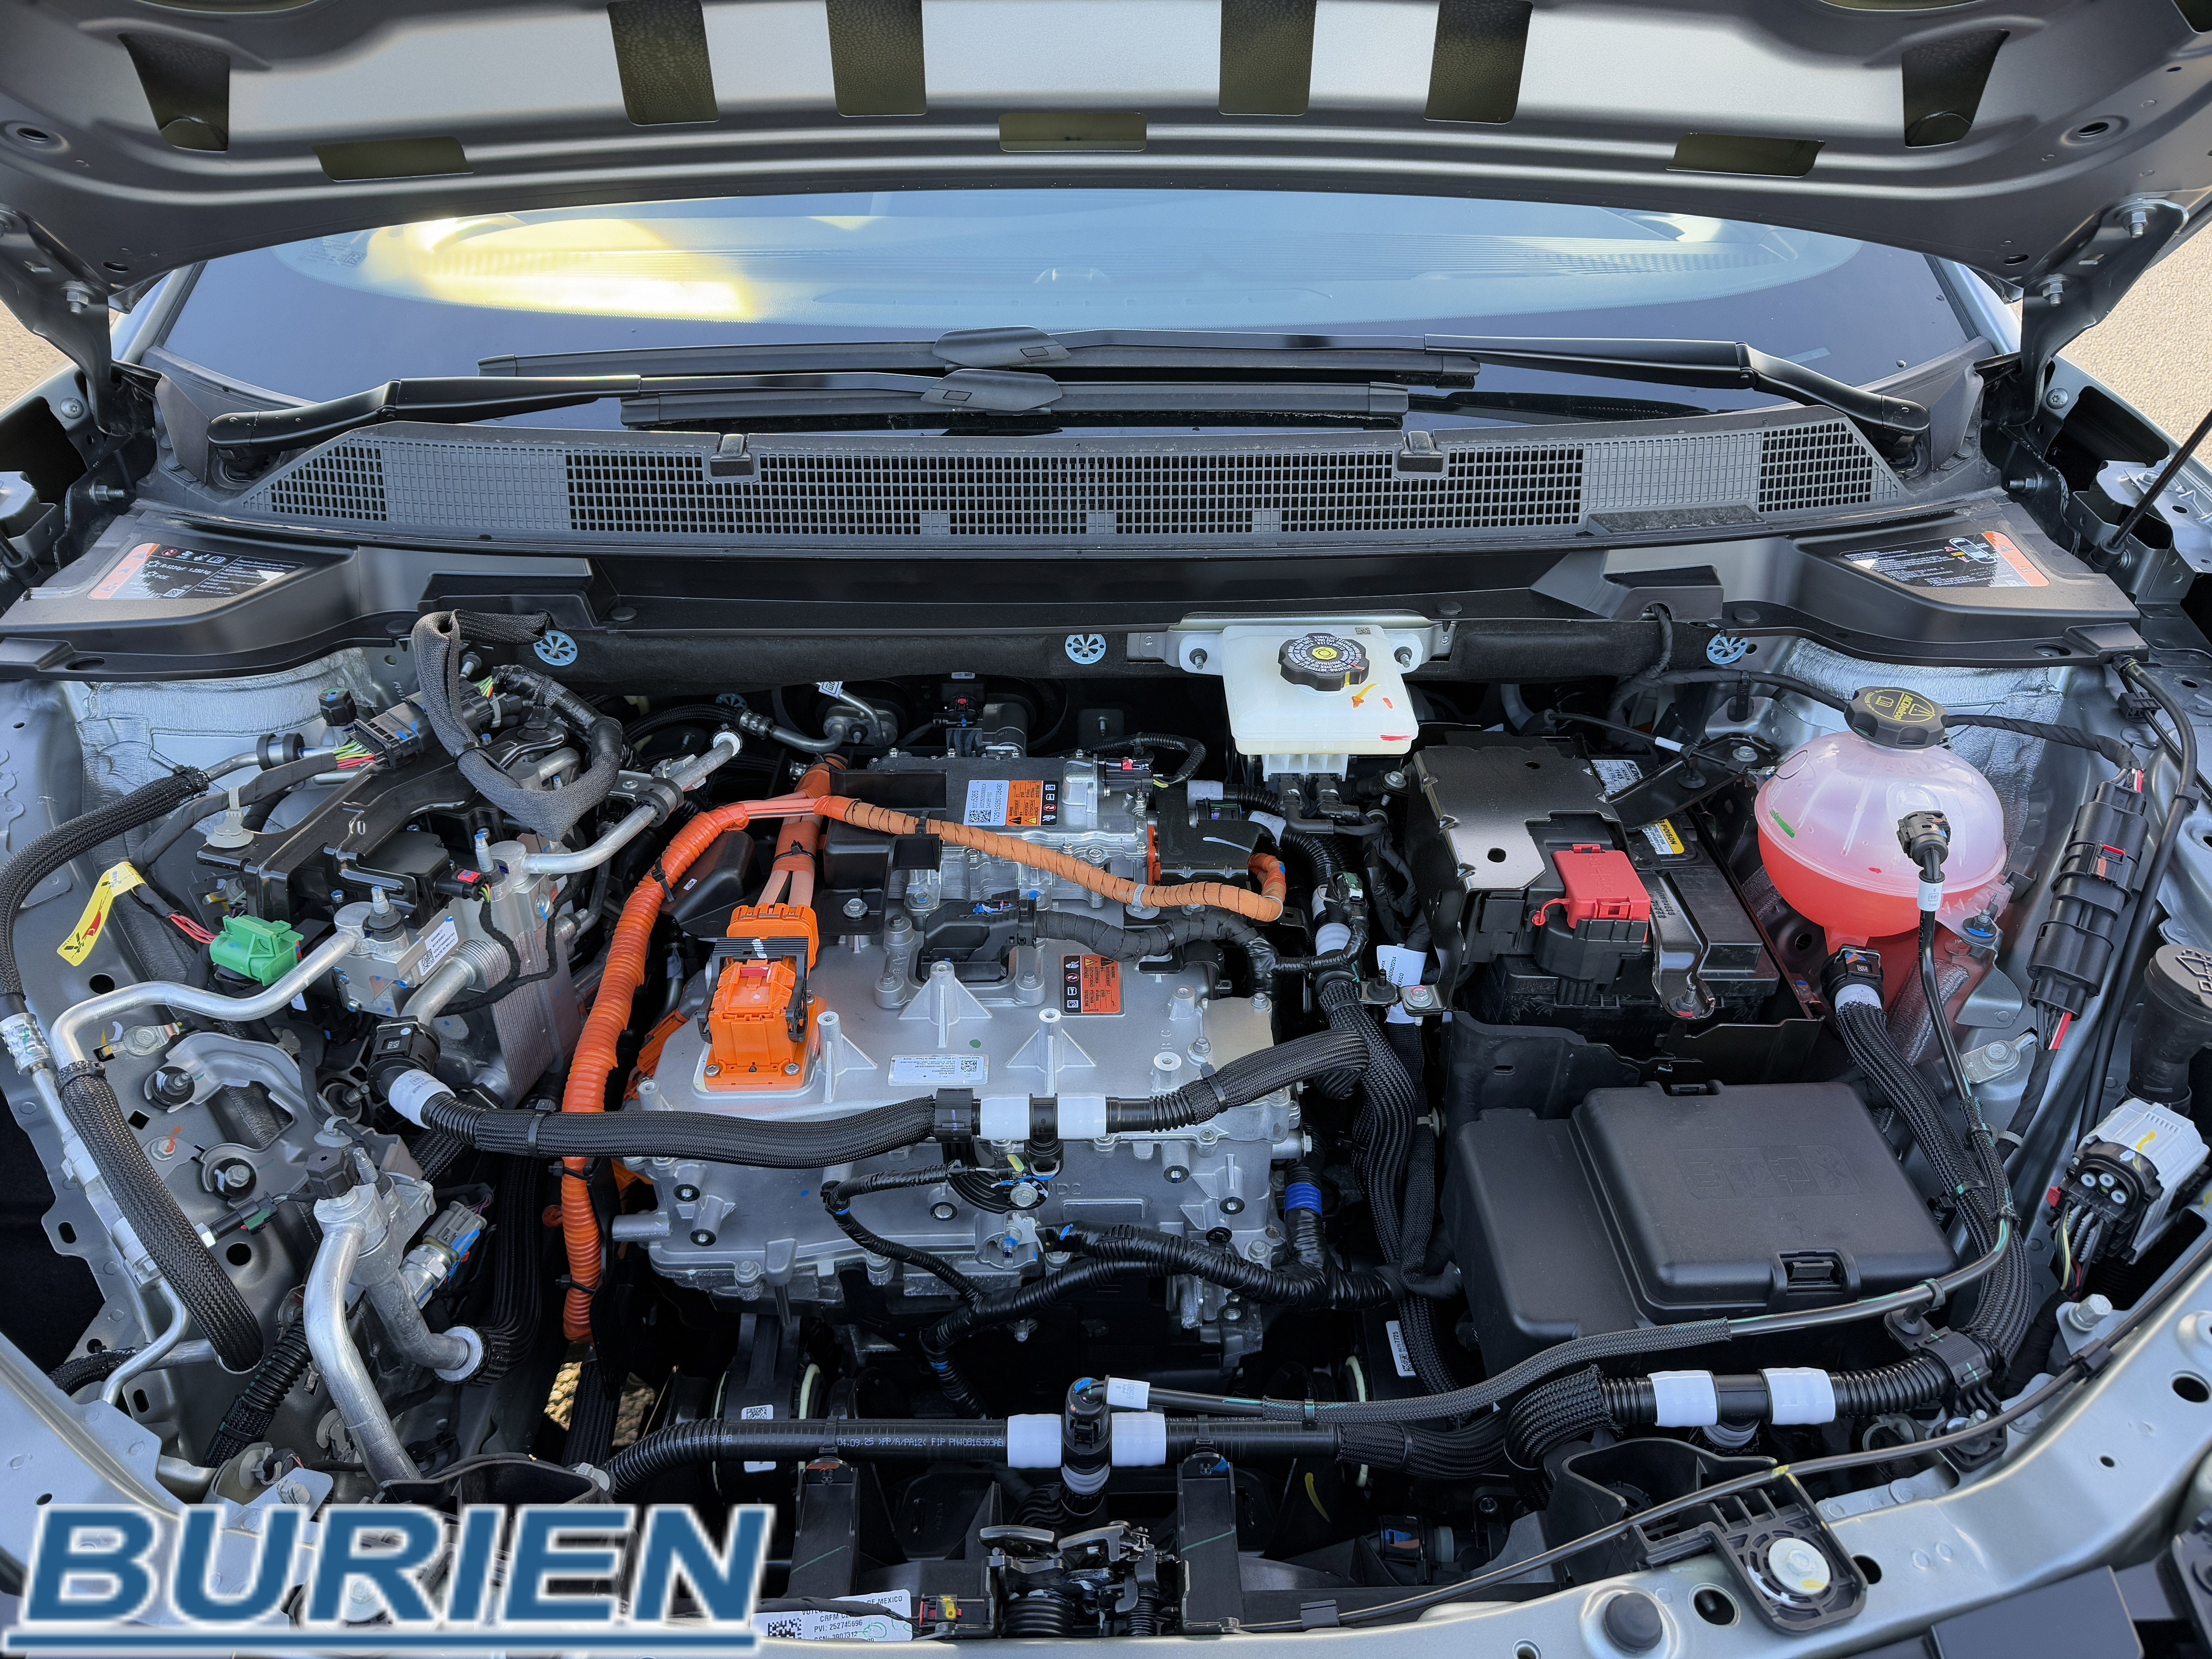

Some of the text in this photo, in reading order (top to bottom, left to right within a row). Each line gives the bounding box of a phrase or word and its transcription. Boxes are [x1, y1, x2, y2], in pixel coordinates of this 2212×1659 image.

[1894, 694, 1913, 720] ACDelco
[837, 1437, 874, 1447] 04.09.25
[931, 1438, 945, 1446] FIP
[878, 1595, 902, 1605] MEXICO
[830, 1620, 863, 1630] 252745696
